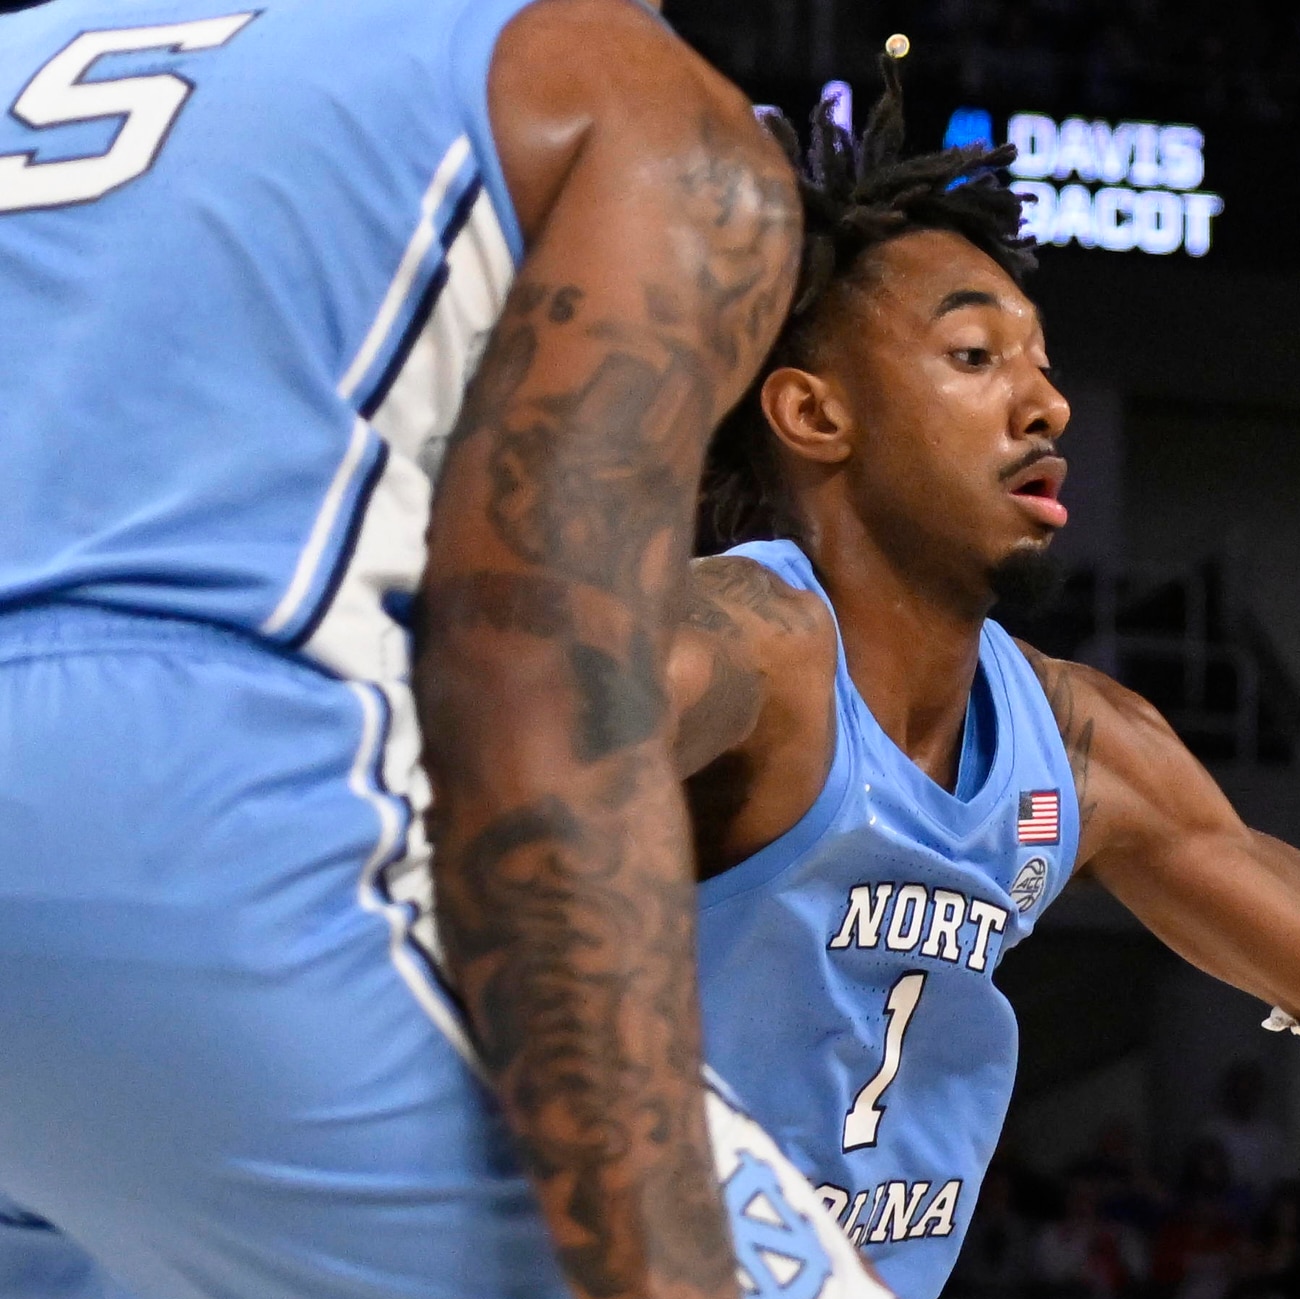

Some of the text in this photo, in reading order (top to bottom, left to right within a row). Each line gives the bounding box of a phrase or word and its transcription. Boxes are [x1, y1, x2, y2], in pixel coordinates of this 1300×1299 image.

[0, 8, 266, 216] 5
[1007, 111, 1205, 191] DAVIS
[1015, 876, 1045, 892] ACC
[842, 968, 929, 1155] 1
